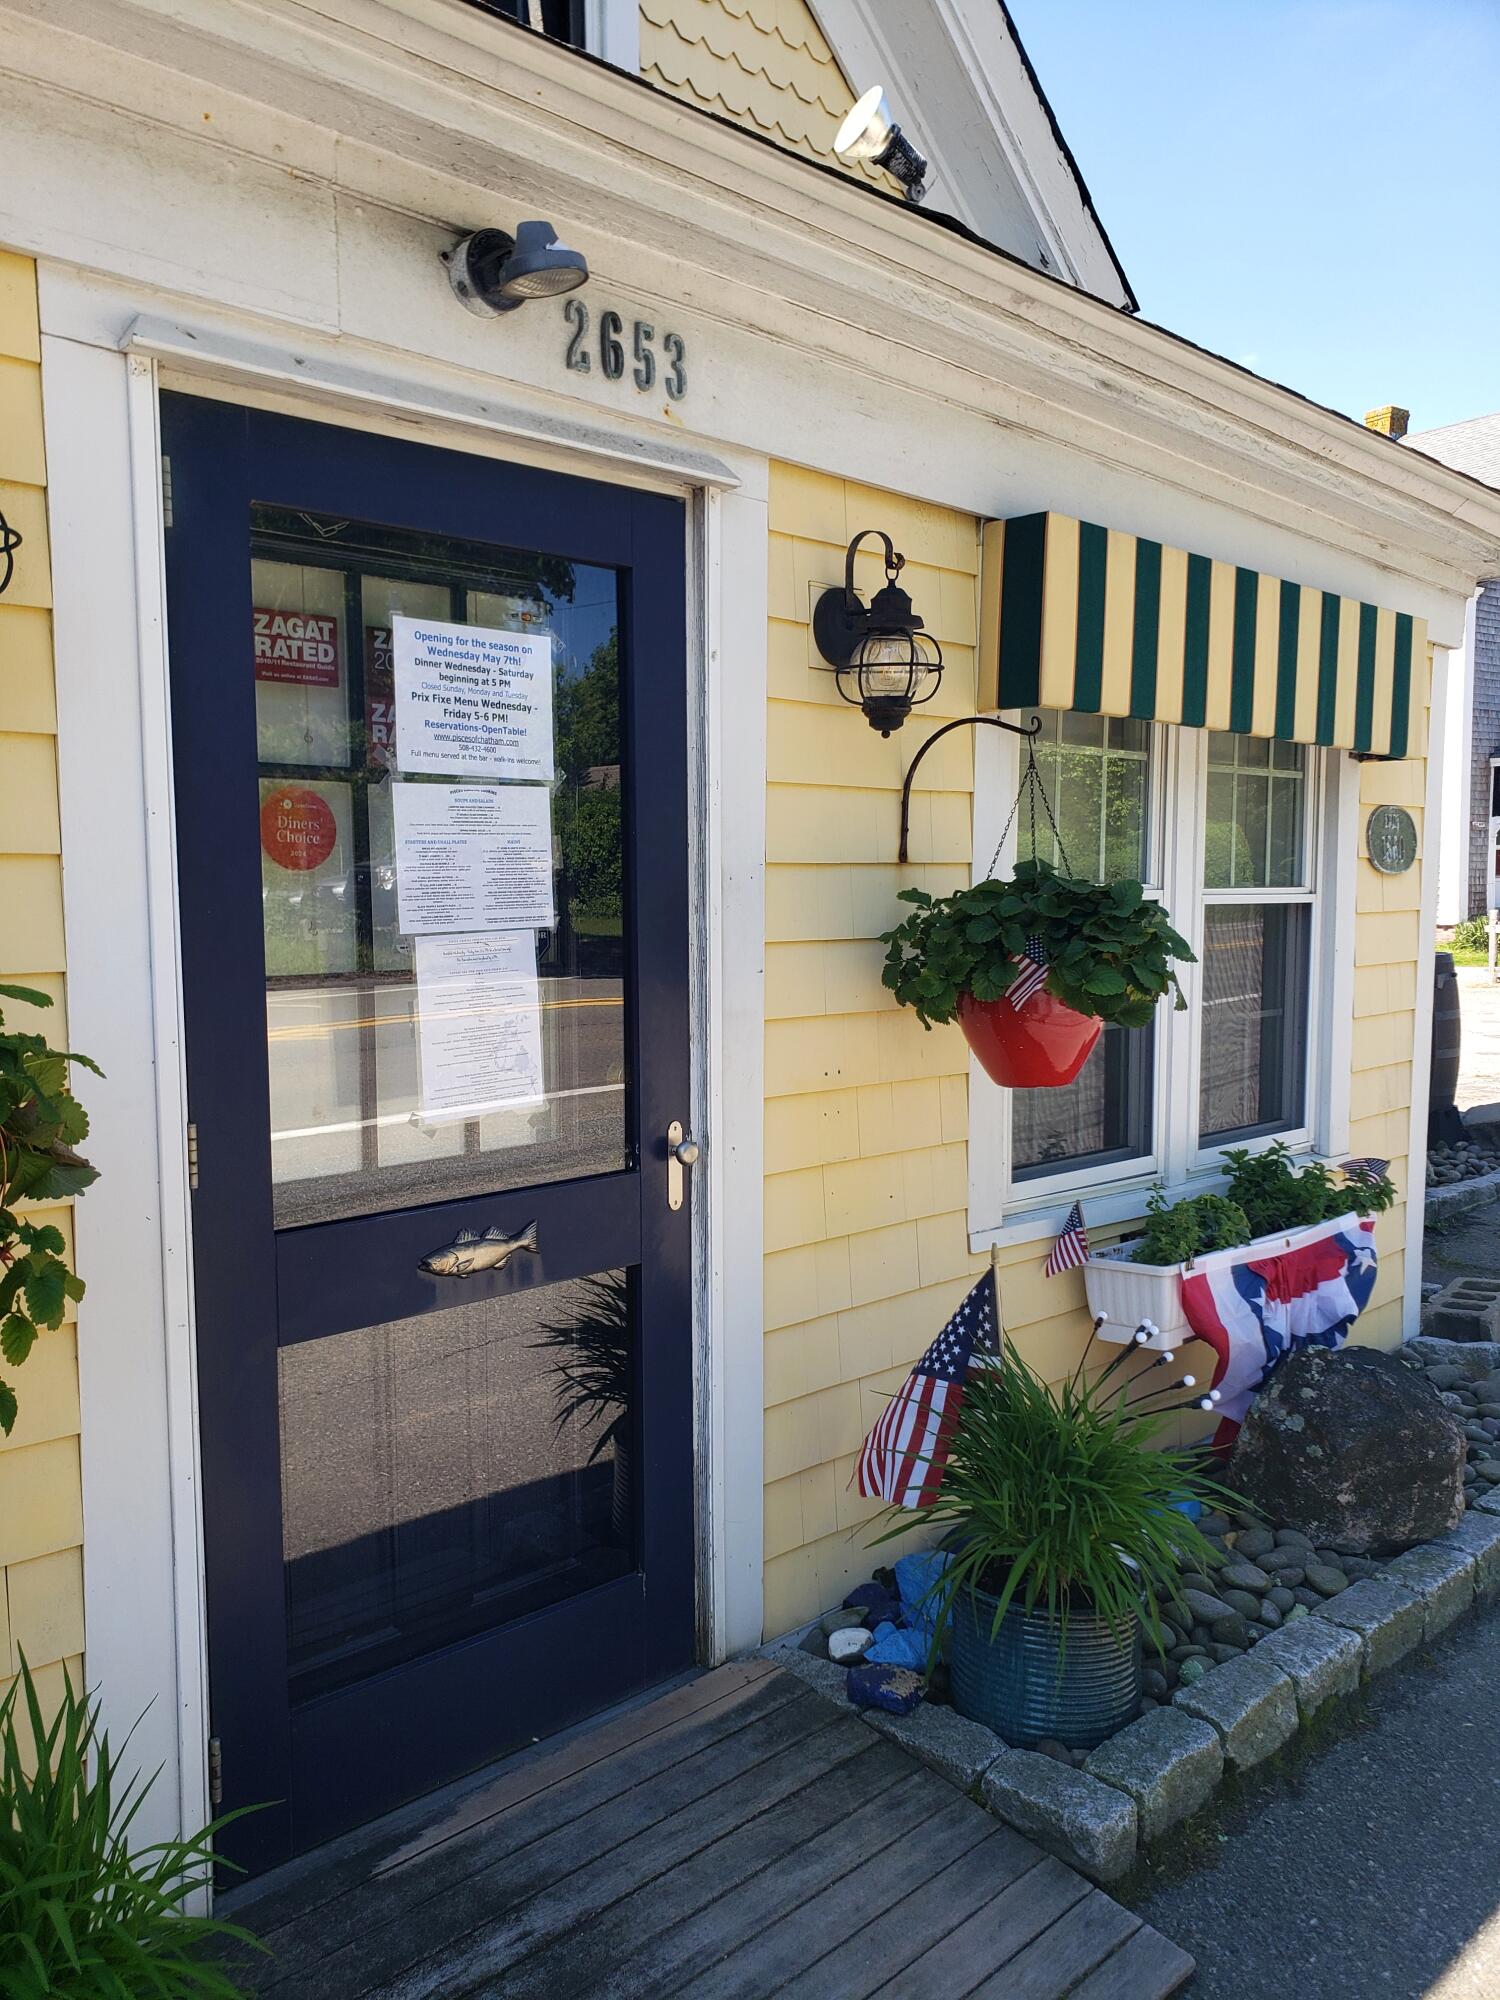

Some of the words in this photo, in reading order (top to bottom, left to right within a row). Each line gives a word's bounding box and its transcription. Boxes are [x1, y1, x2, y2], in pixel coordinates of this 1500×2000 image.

[564, 299, 688, 401] 2653
[253, 613, 334, 642] ZAGAT
[254, 634, 335, 664] RATED
[414, 630, 454, 646] Opening
[456, 636, 469, 646] for
[471, 638, 486, 649] the
[488, 642, 520, 653] season
[522, 645, 533, 655] on
[427, 645, 481, 662] Wednesday
[482, 653, 501, 665] May
[503, 655, 521, 666] 7th!
[414, 658, 442, 669] Dinner
[444, 661, 491, 675] Wednesday
[498, 668, 534, 680] Saturday
[439, 672, 479, 686] beginning
[481, 677, 489, 686] at
[491, 678, 497, 686] 5
[499, 679, 511, 688] PM
[421, 681, 441, 691] Closed
[442, 683, 466, 694] Sunday,
[467, 687, 491, 697] Monday
[492, 690, 504, 698] and
[505, 690, 528, 700] Tuesday
[411, 691, 430, 702] Prix
[432, 694, 452, 705] Fixe
[454, 696, 479, 708] Menu
[481, 699, 532, 714] Wednesday
[443, 708, 472, 721] Friday
[474, 711, 490, 721] 5-6
[491, 713, 509, 723] PM!
[424, 719, 527, 737] Reservations-OpenTable!
[434, 733, 520, 747] www.piscesofchatham.com
[410, 749, 421, 757] Full
[440, 751, 460, 760] served
[468, 753, 477, 761] the
[277, 815, 323, 831] Diners'
[276, 829, 321, 844] Choice
